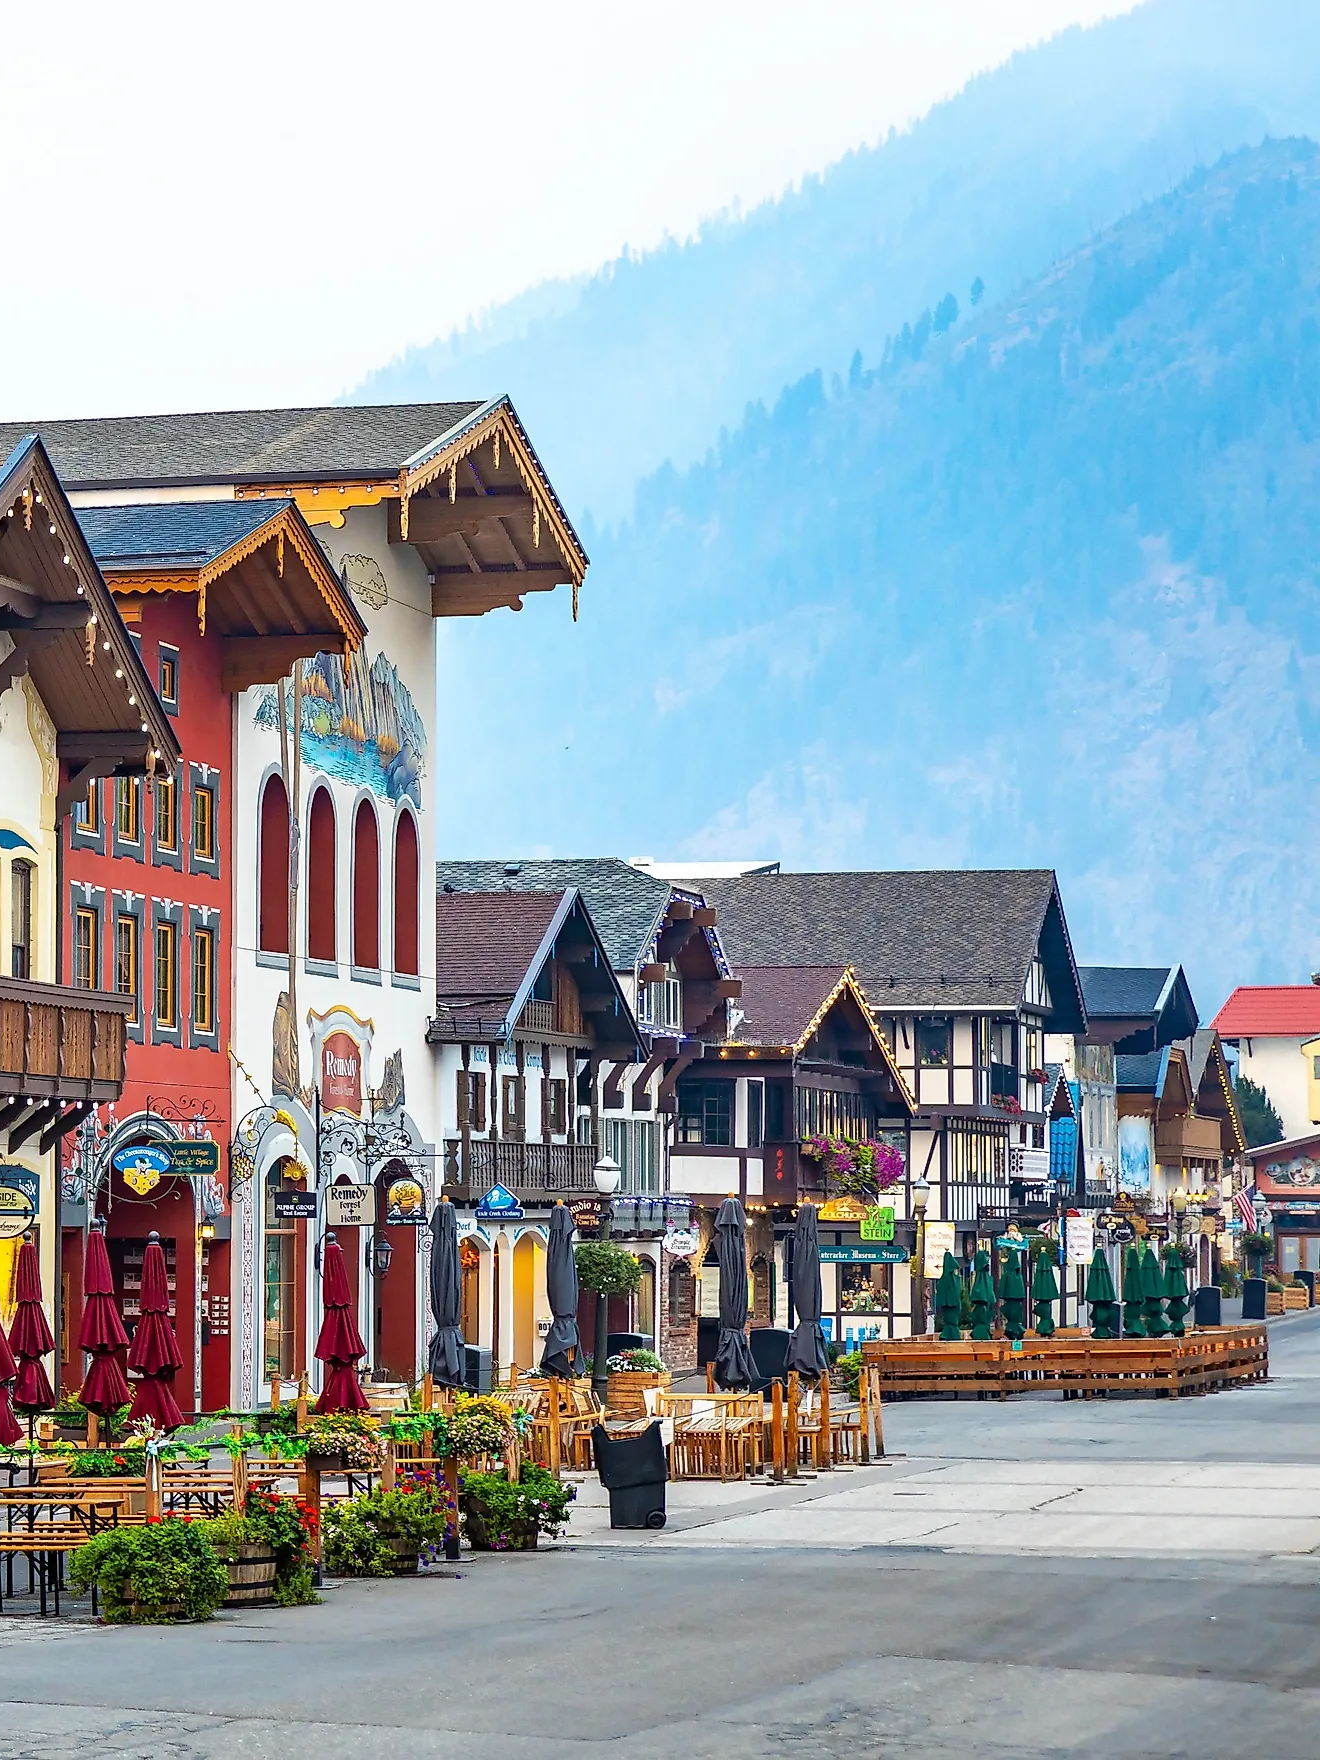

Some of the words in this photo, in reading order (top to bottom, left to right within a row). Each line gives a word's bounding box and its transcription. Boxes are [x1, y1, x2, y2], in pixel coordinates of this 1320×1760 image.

[190, 1149, 210, 1158] Village
[195, 1158, 214, 1167] Spice
[331, 1186, 368, 1201] Remedy
[340, 1201, 361, 1209] Forest
[340, 1215, 362, 1223] Home
[864, 1228, 892, 1238] STEIN
[819, 1251, 848, 1259] utcracker
[850, 1249, 877, 1259] Museum
[881, 1249, 900, 1259] Store
